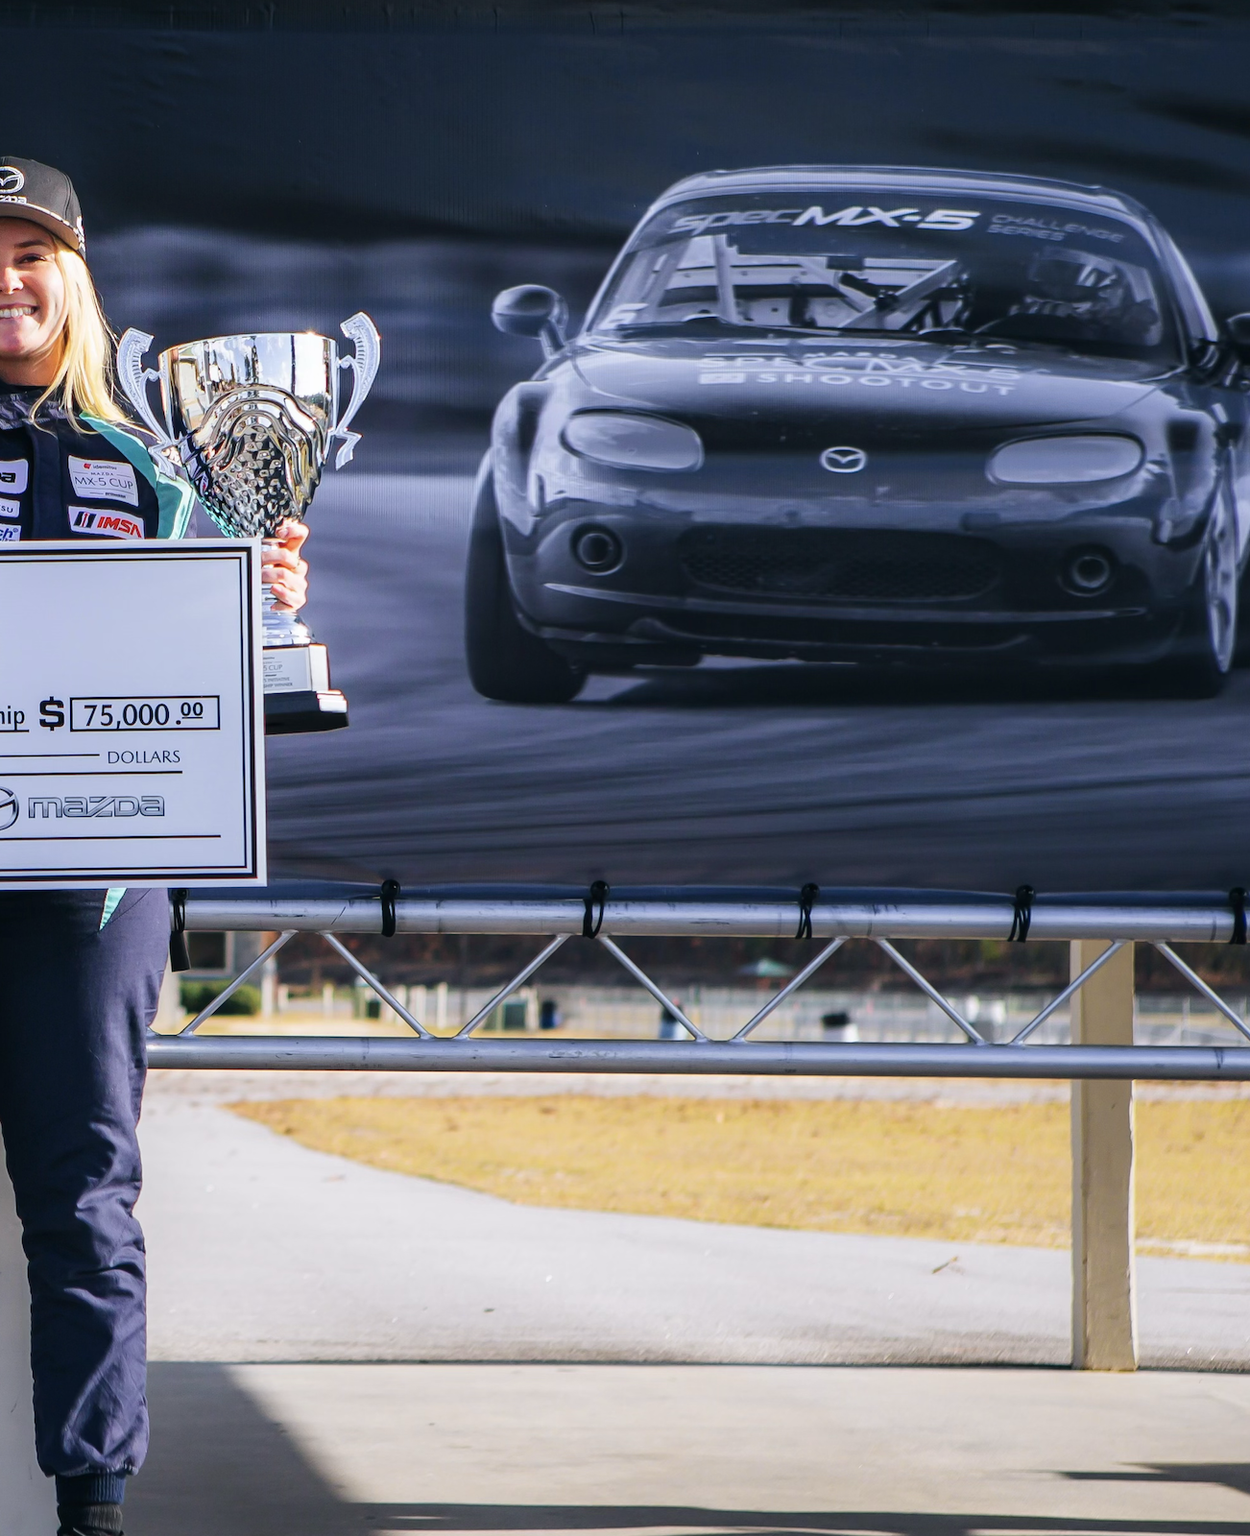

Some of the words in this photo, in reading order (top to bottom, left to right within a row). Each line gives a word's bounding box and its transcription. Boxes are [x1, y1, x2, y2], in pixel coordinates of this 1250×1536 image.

[756, 373, 1015, 396] SHOOTOUT
[74, 476, 107, 488] MX-5
[109, 477, 134, 490] CUP
[39, 696, 65, 731] $
[107, 750, 181, 764] DOLLARS
